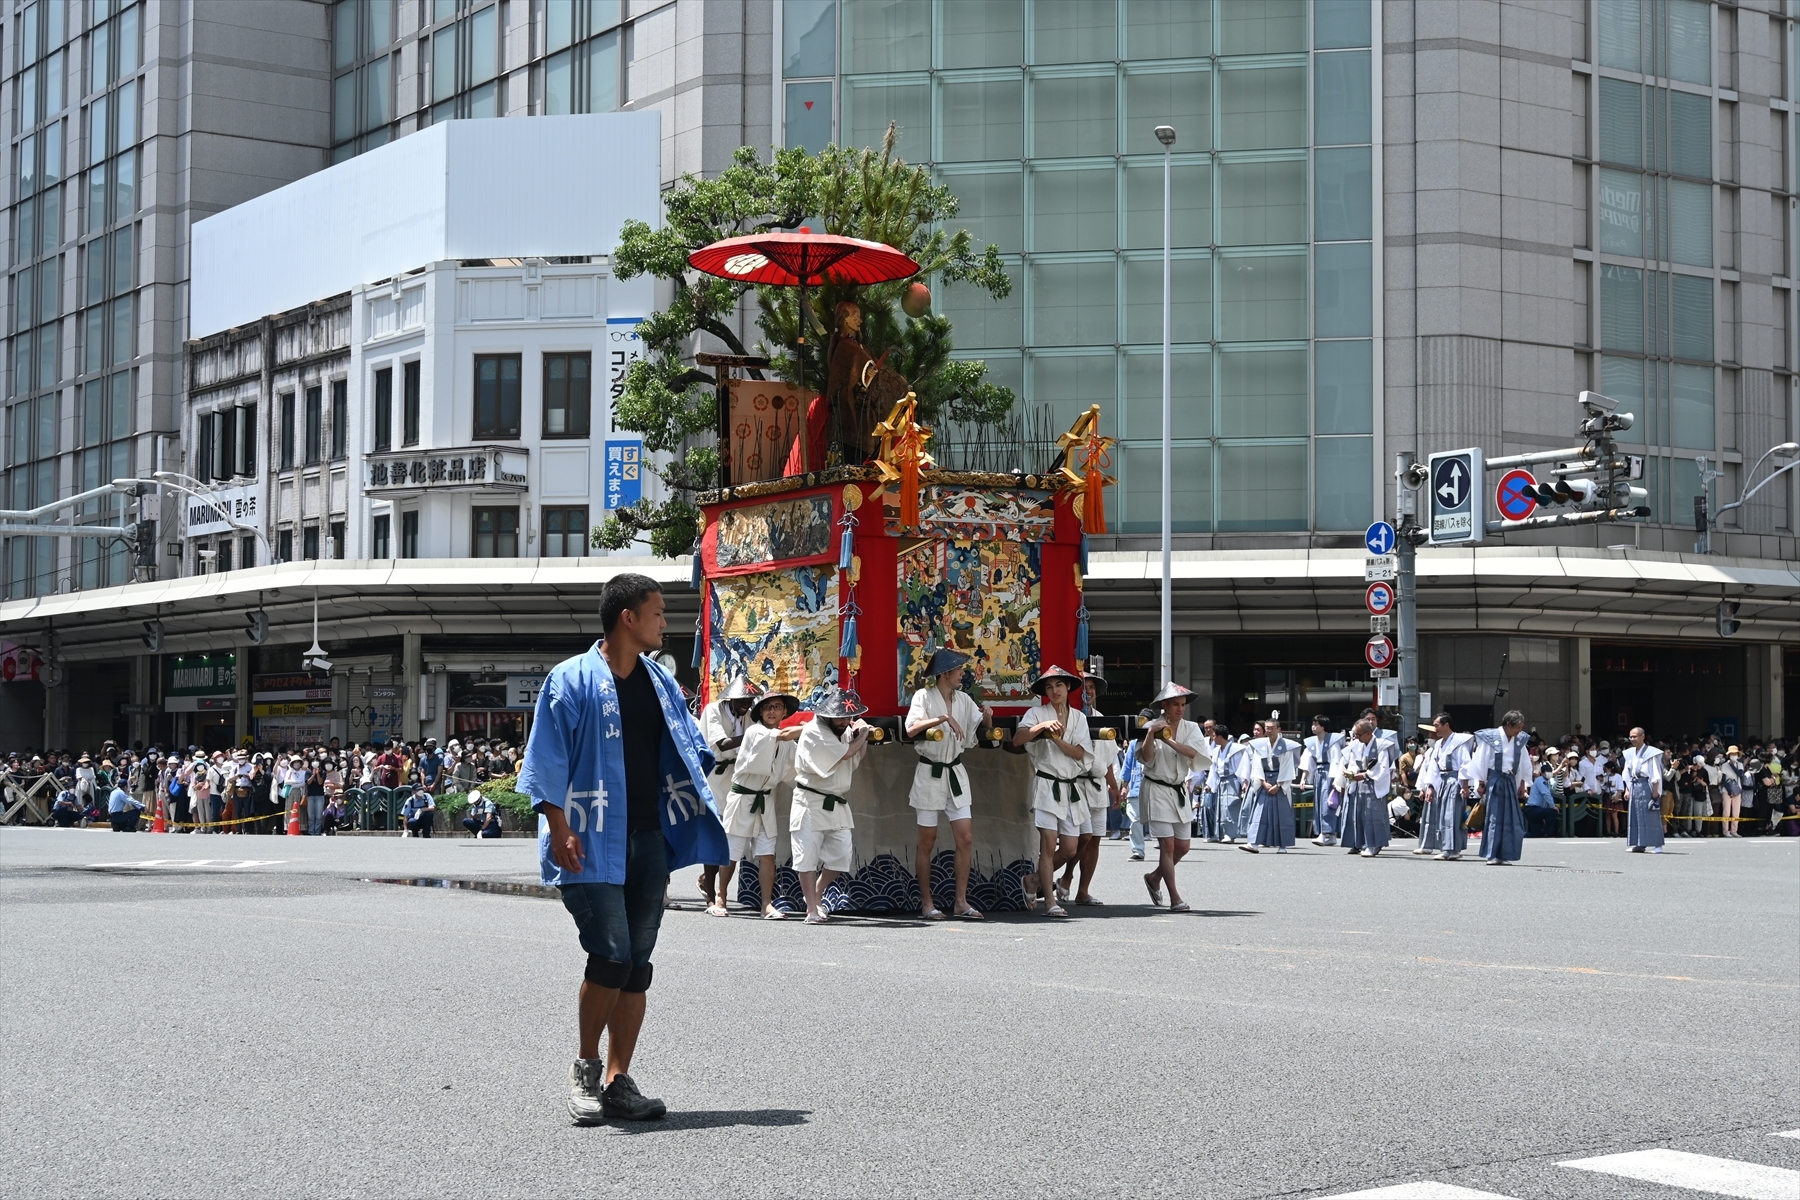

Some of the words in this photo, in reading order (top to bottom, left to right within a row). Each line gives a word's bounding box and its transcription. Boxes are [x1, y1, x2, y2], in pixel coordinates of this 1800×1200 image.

[370, 456, 487, 487] 池善化粧品店
[608, 447, 622, 507] 買えます
[624, 447, 638, 480] すぐ
[235, 496, 257, 519] 雲の茶
[173, 667, 214, 688] MARUMARU
[269, 705, 282, 716] Money
